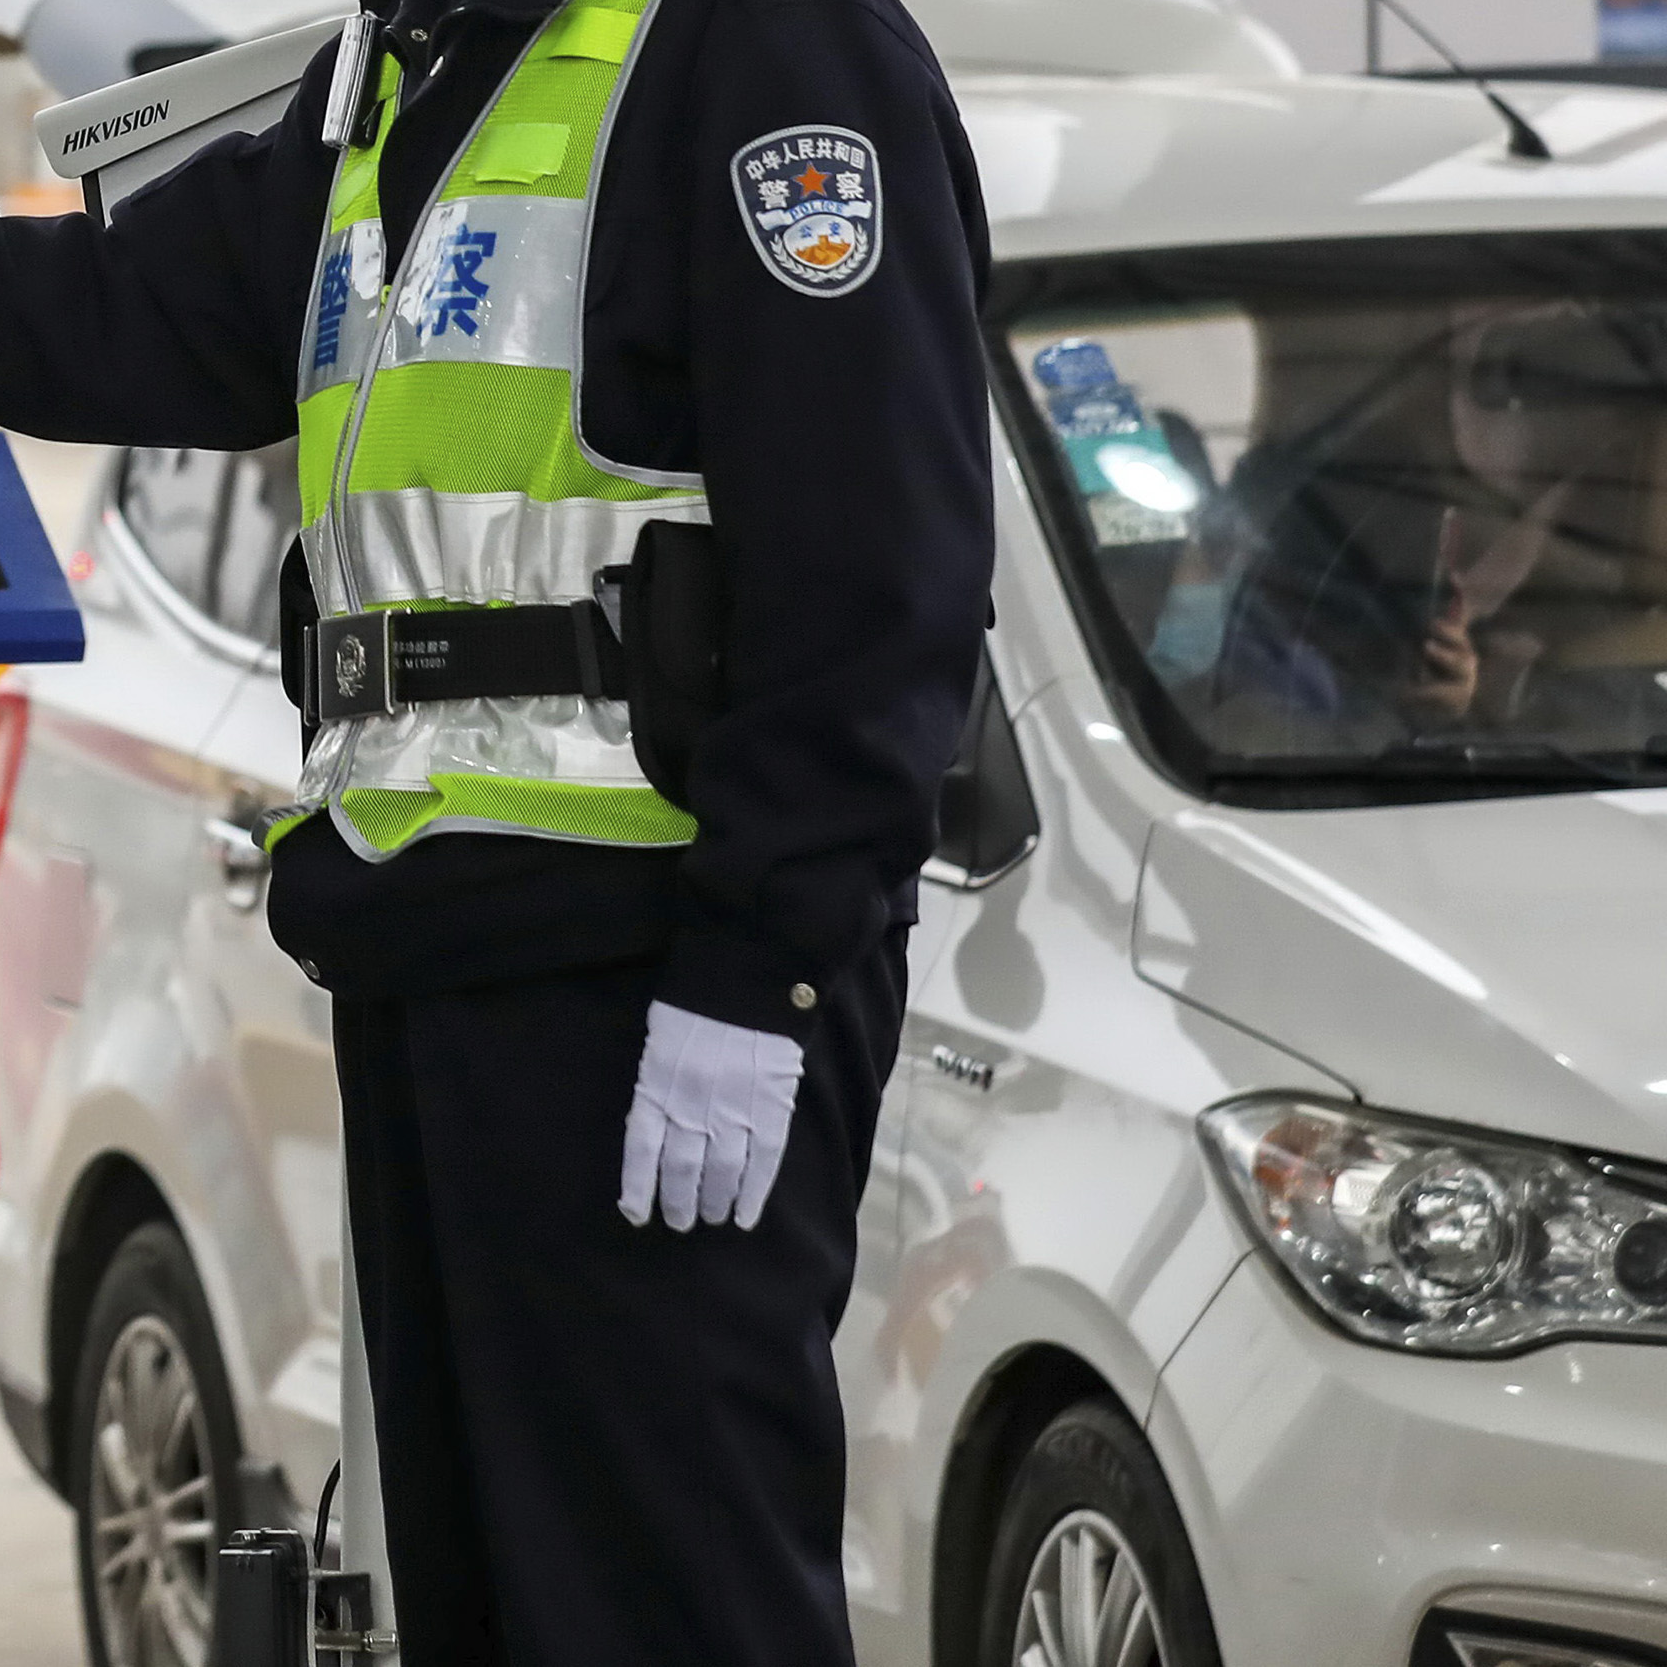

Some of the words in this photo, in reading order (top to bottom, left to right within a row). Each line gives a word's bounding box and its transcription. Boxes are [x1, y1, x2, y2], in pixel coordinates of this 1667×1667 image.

[61, 98, 170, 156] HIKVISION
[745, 138, 866, 181] 中华人民共和国
[757, 180, 791, 210] 警
[835, 171, 865, 201] 察
[789, 200, 845, 221] POLICE
[415, 222, 498, 337] 察
